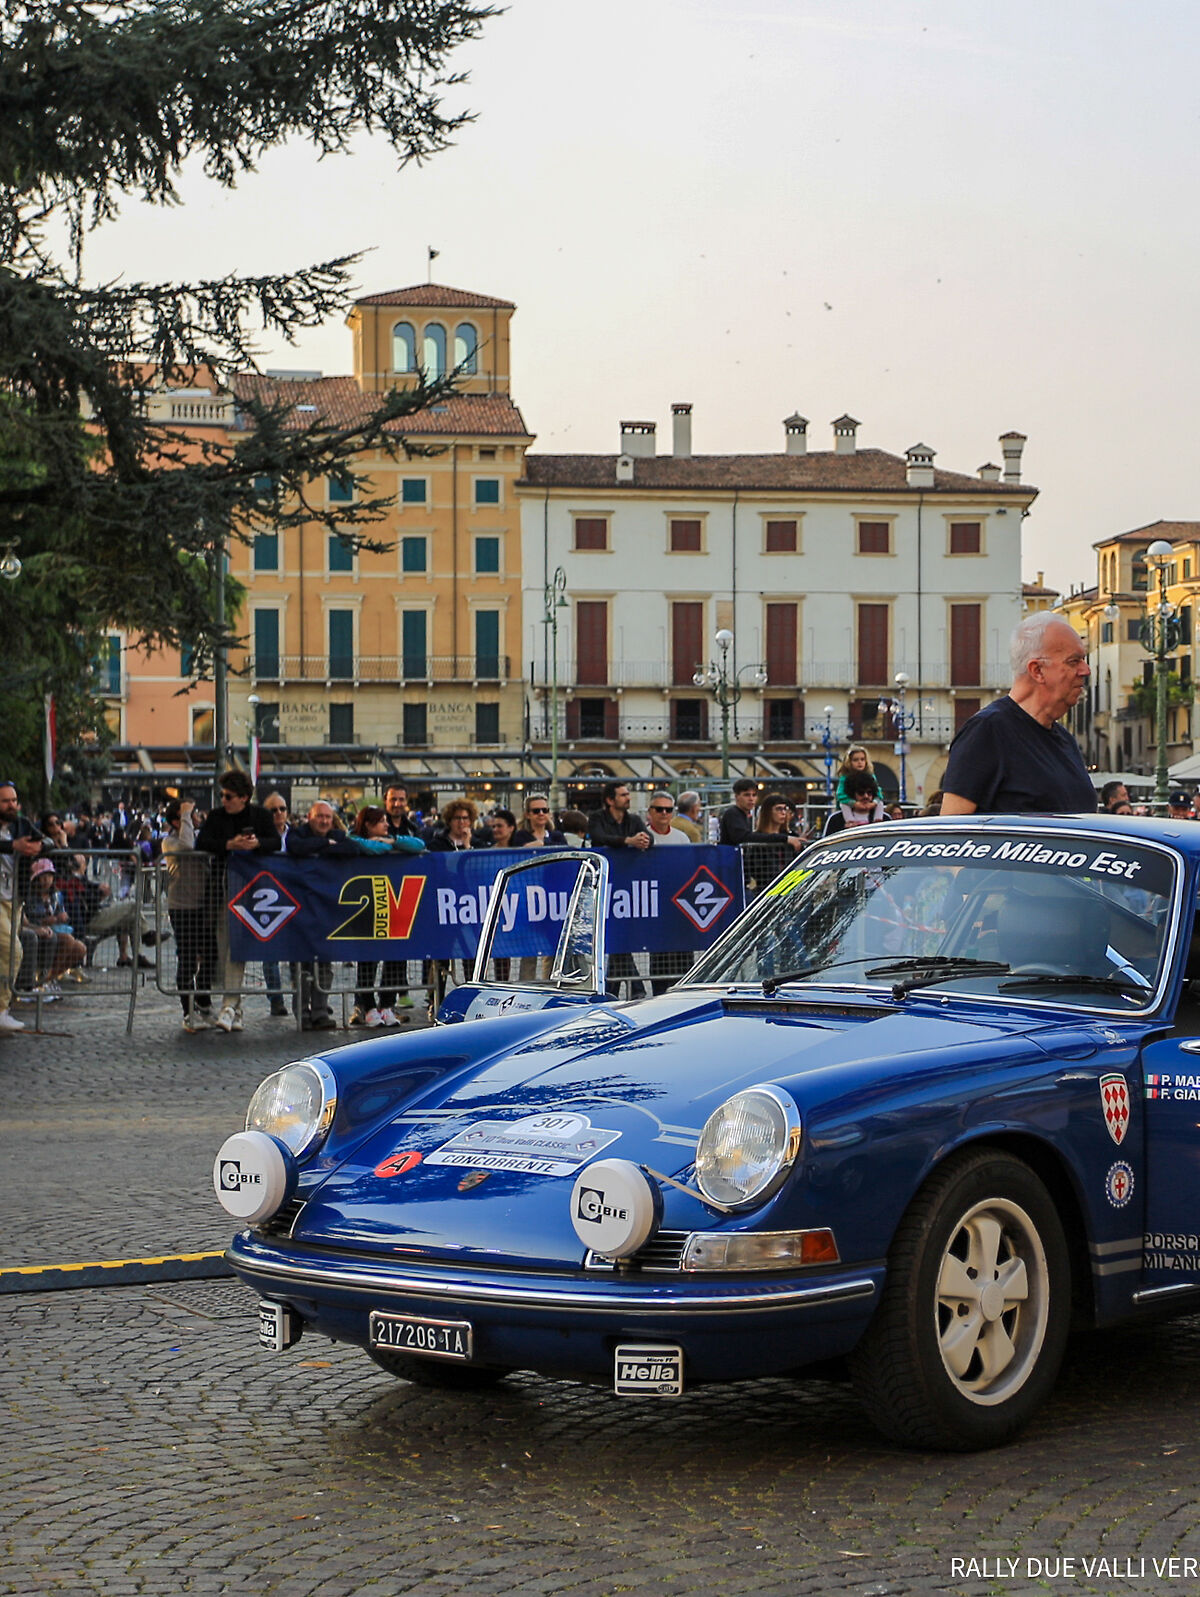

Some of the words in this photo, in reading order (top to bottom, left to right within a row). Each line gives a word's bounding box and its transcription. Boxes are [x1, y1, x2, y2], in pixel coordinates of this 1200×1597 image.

[282, 703, 327, 714] BANCA
[429, 703, 473, 714] BANCA
[806, 845, 886, 868] Centro
[885, 840, 992, 859] Porsche
[991, 841, 1088, 867] Milano
[1088, 852, 1142, 879] Est
[374, 877, 388, 910] VALLI
[375, 912, 389, 938] DUE
[1161, 1076, 1172, 1086] P.
[1160, 1089, 1171, 1100] F.
[532, 1117, 575, 1130] 301
[533, 1139, 572, 1150] CLASSIC
[379, 1155, 413, 1173] A
[441, 1155, 559, 1173] CONCORRENTE
[377, 1321, 437, 1349] 217206
[442, 1328, 464, 1353] TA
[620, 1364, 675, 1380] Hella
